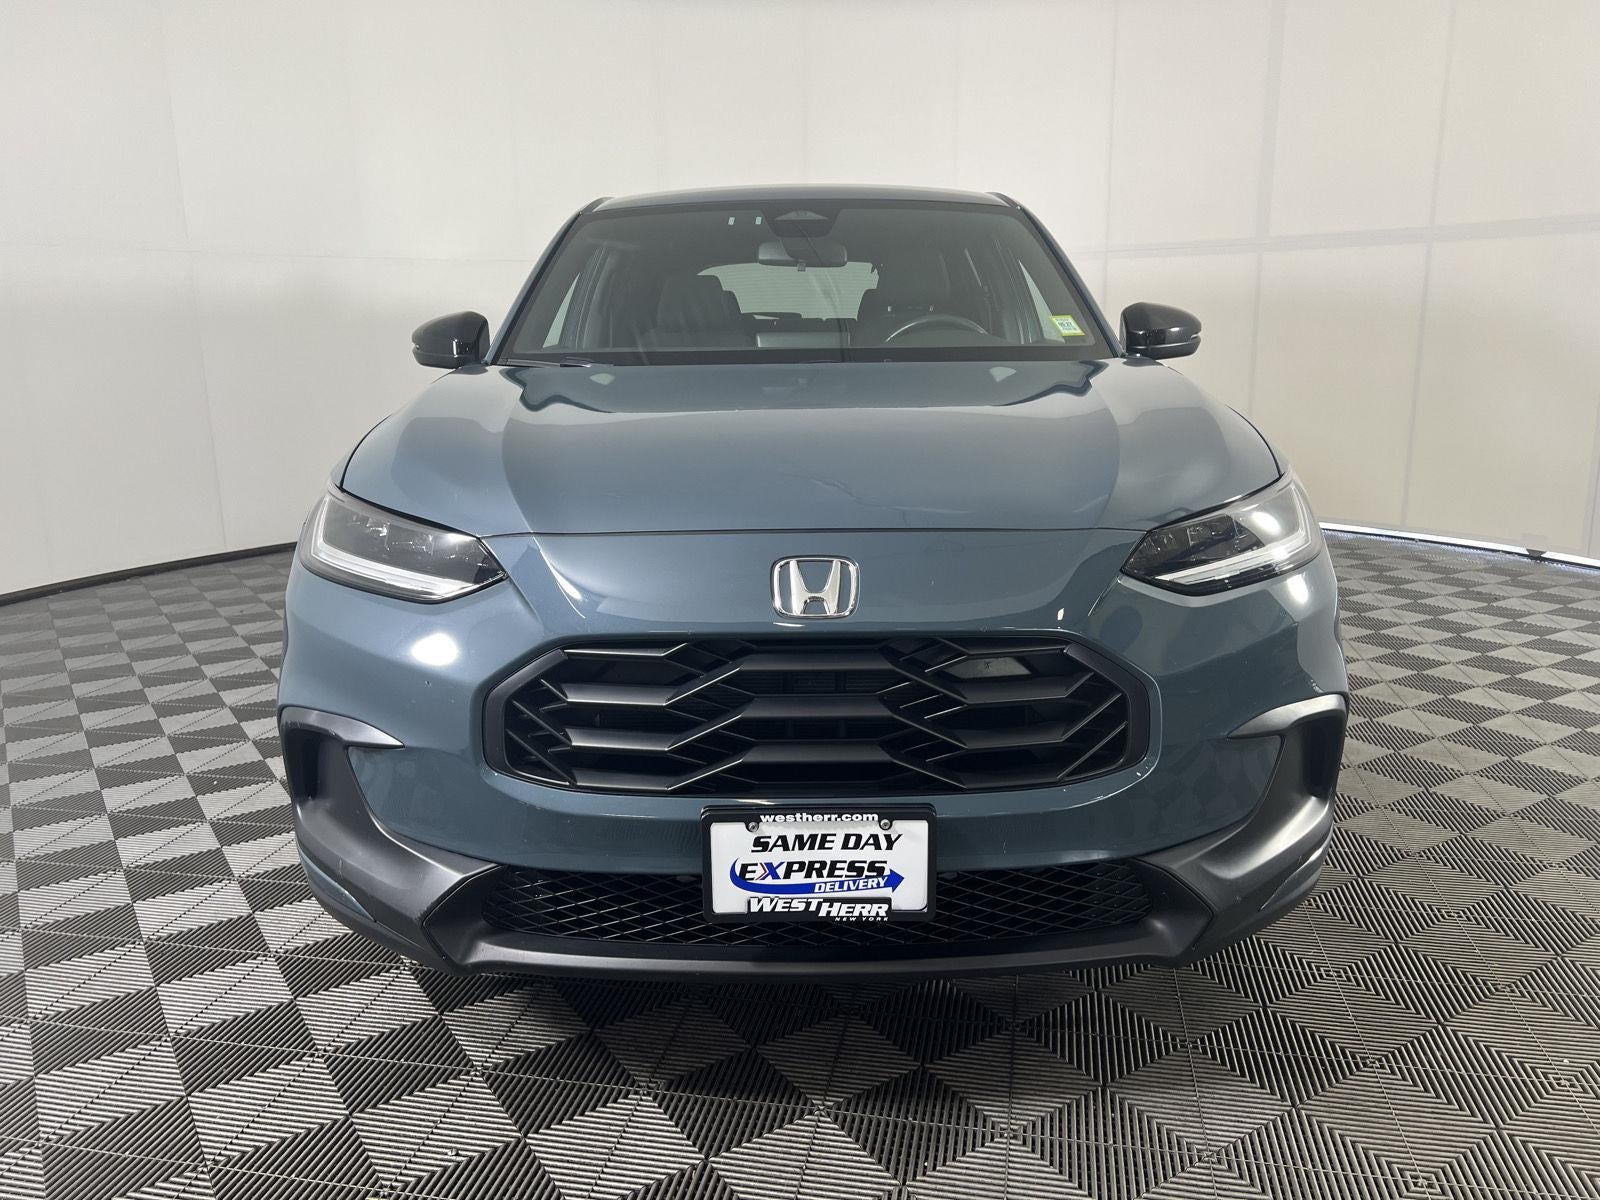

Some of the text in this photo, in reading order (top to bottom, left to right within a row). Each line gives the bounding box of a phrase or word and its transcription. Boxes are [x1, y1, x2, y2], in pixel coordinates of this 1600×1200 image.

[759, 812, 879, 823] westherr.com
[751, 833, 903, 853] SAME DAY
[738, 860, 888, 881] EXPRESS
[813, 875, 889, 893] DELIVERY
